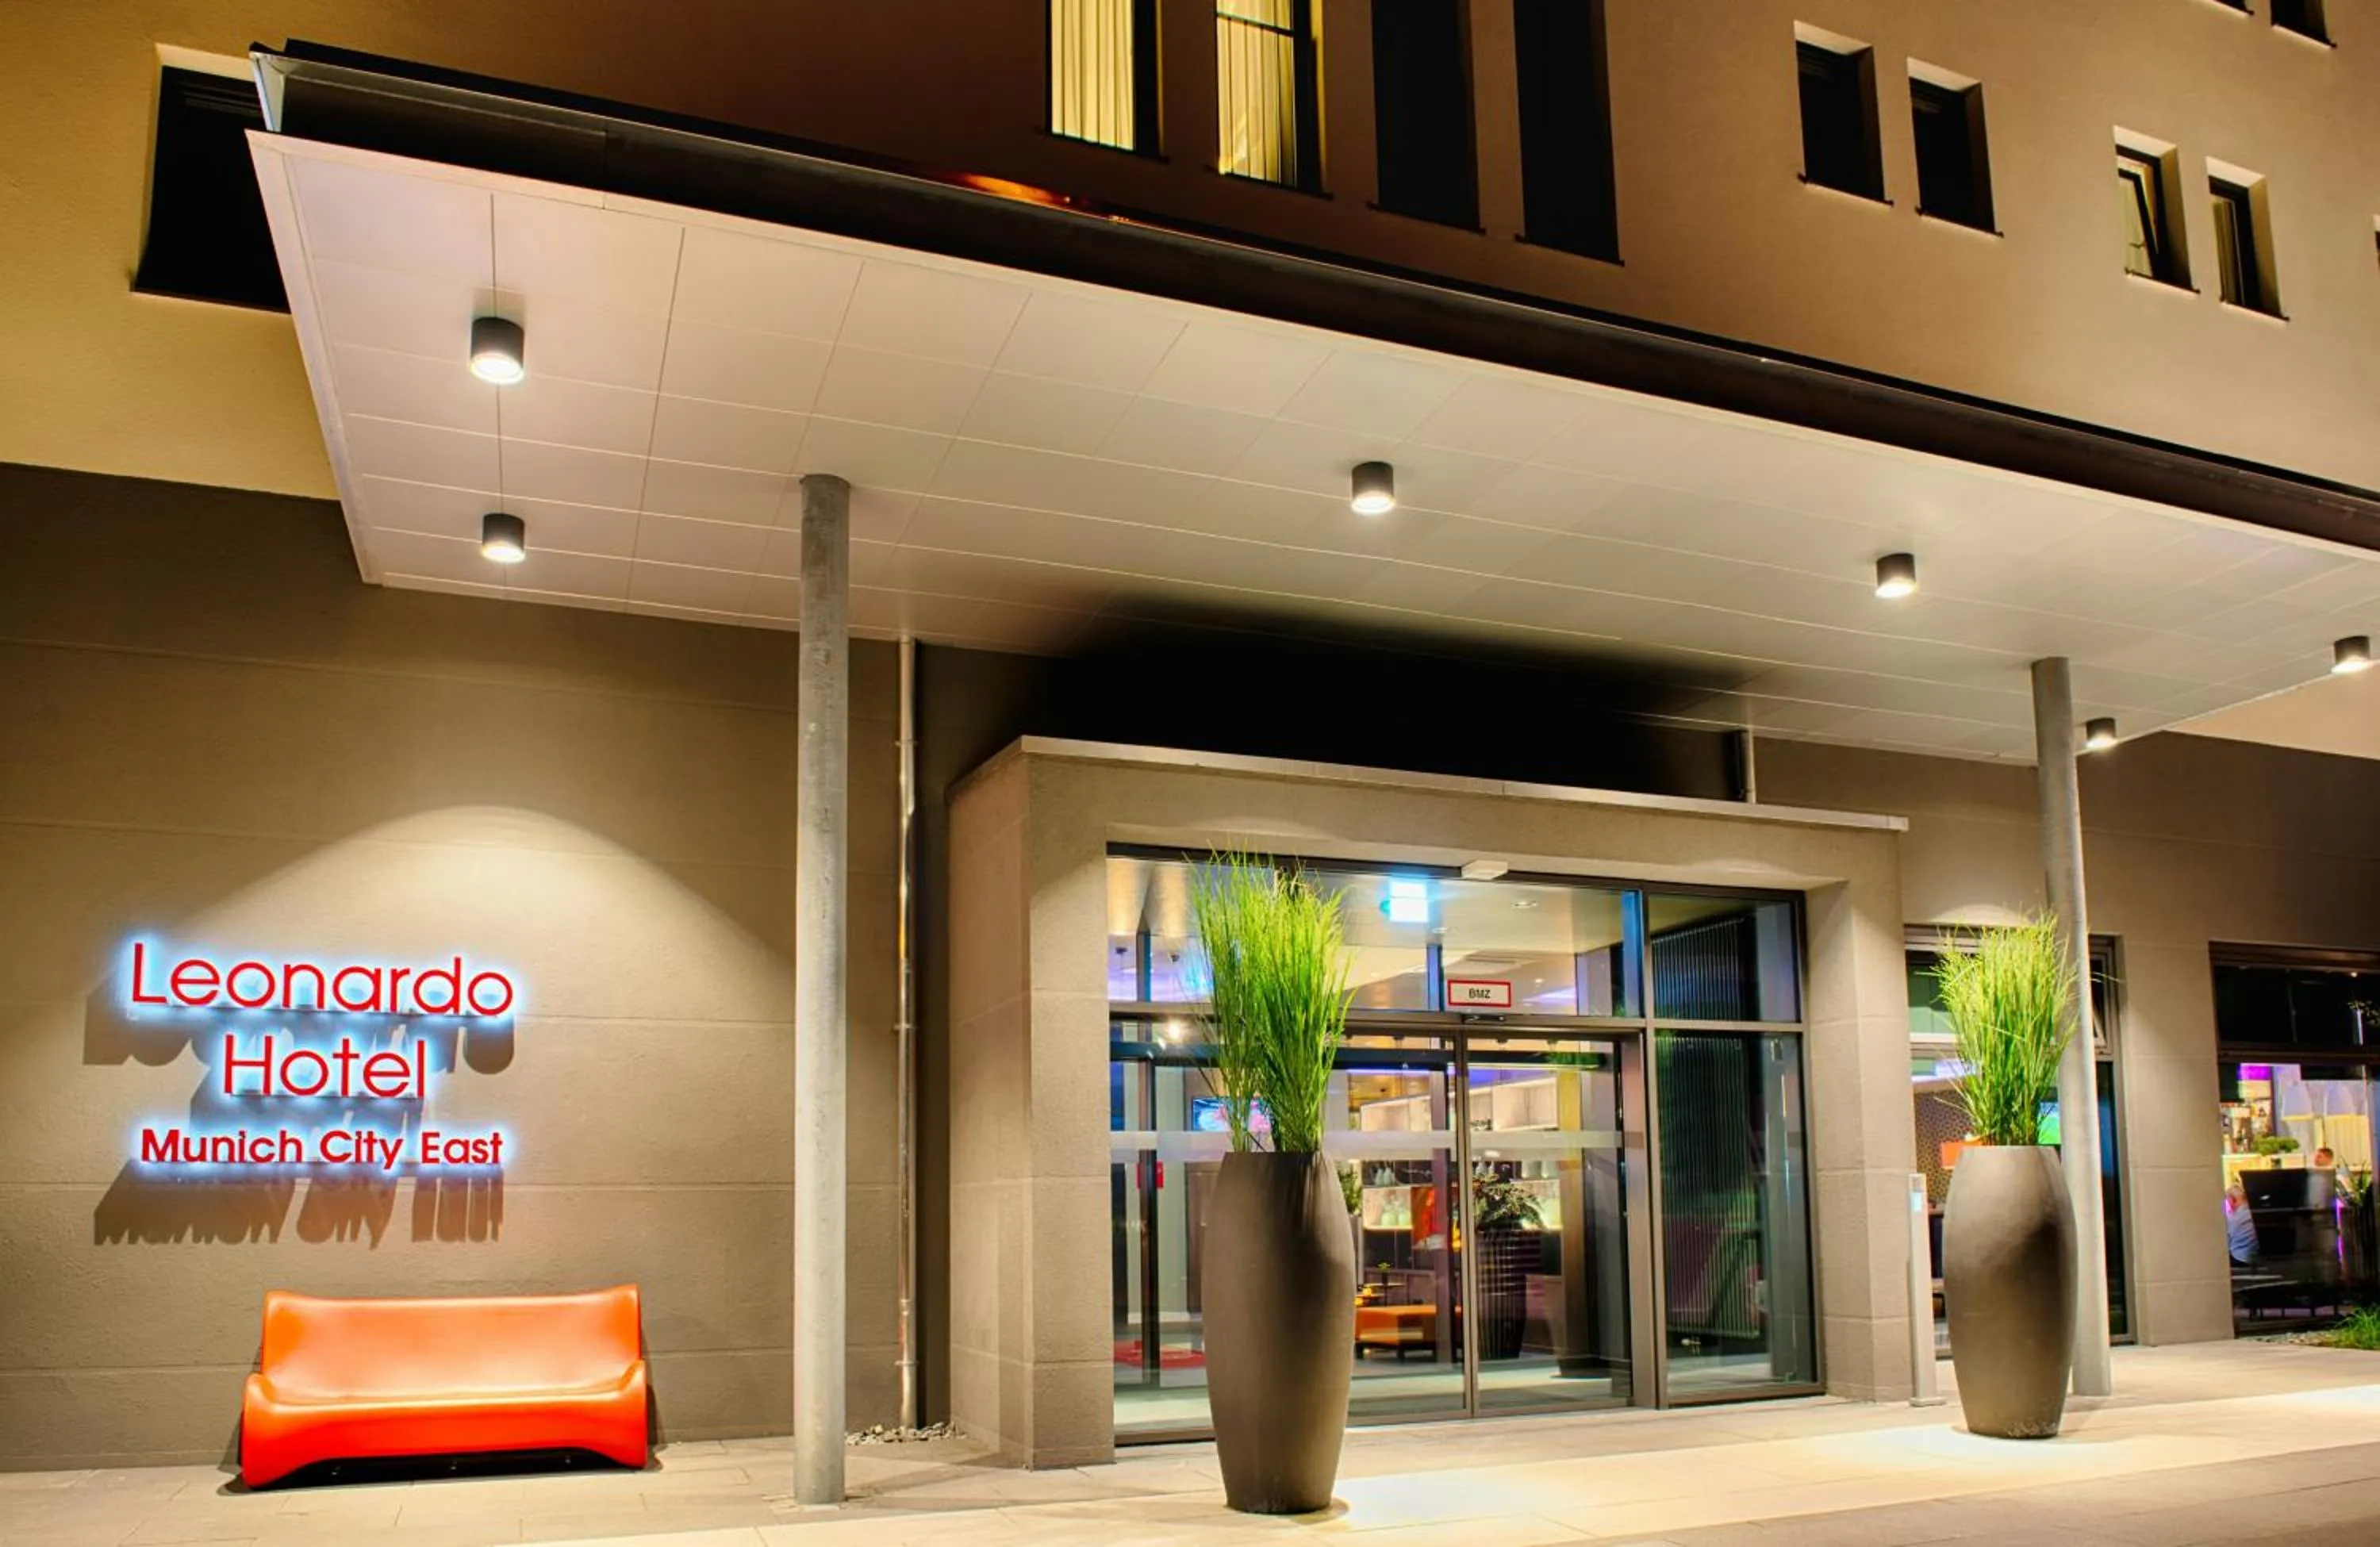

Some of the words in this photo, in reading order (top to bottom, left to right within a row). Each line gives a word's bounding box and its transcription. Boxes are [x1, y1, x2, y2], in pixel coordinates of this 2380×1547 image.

[132, 942, 513, 1015] Leonardo
[1468, 988, 1491, 999] BMZ
[223, 1034, 425, 1097] Hotel
[141, 1129, 302, 1162] Munich
[320, 1130, 403, 1169] City
[421, 1131, 503, 1164] East
